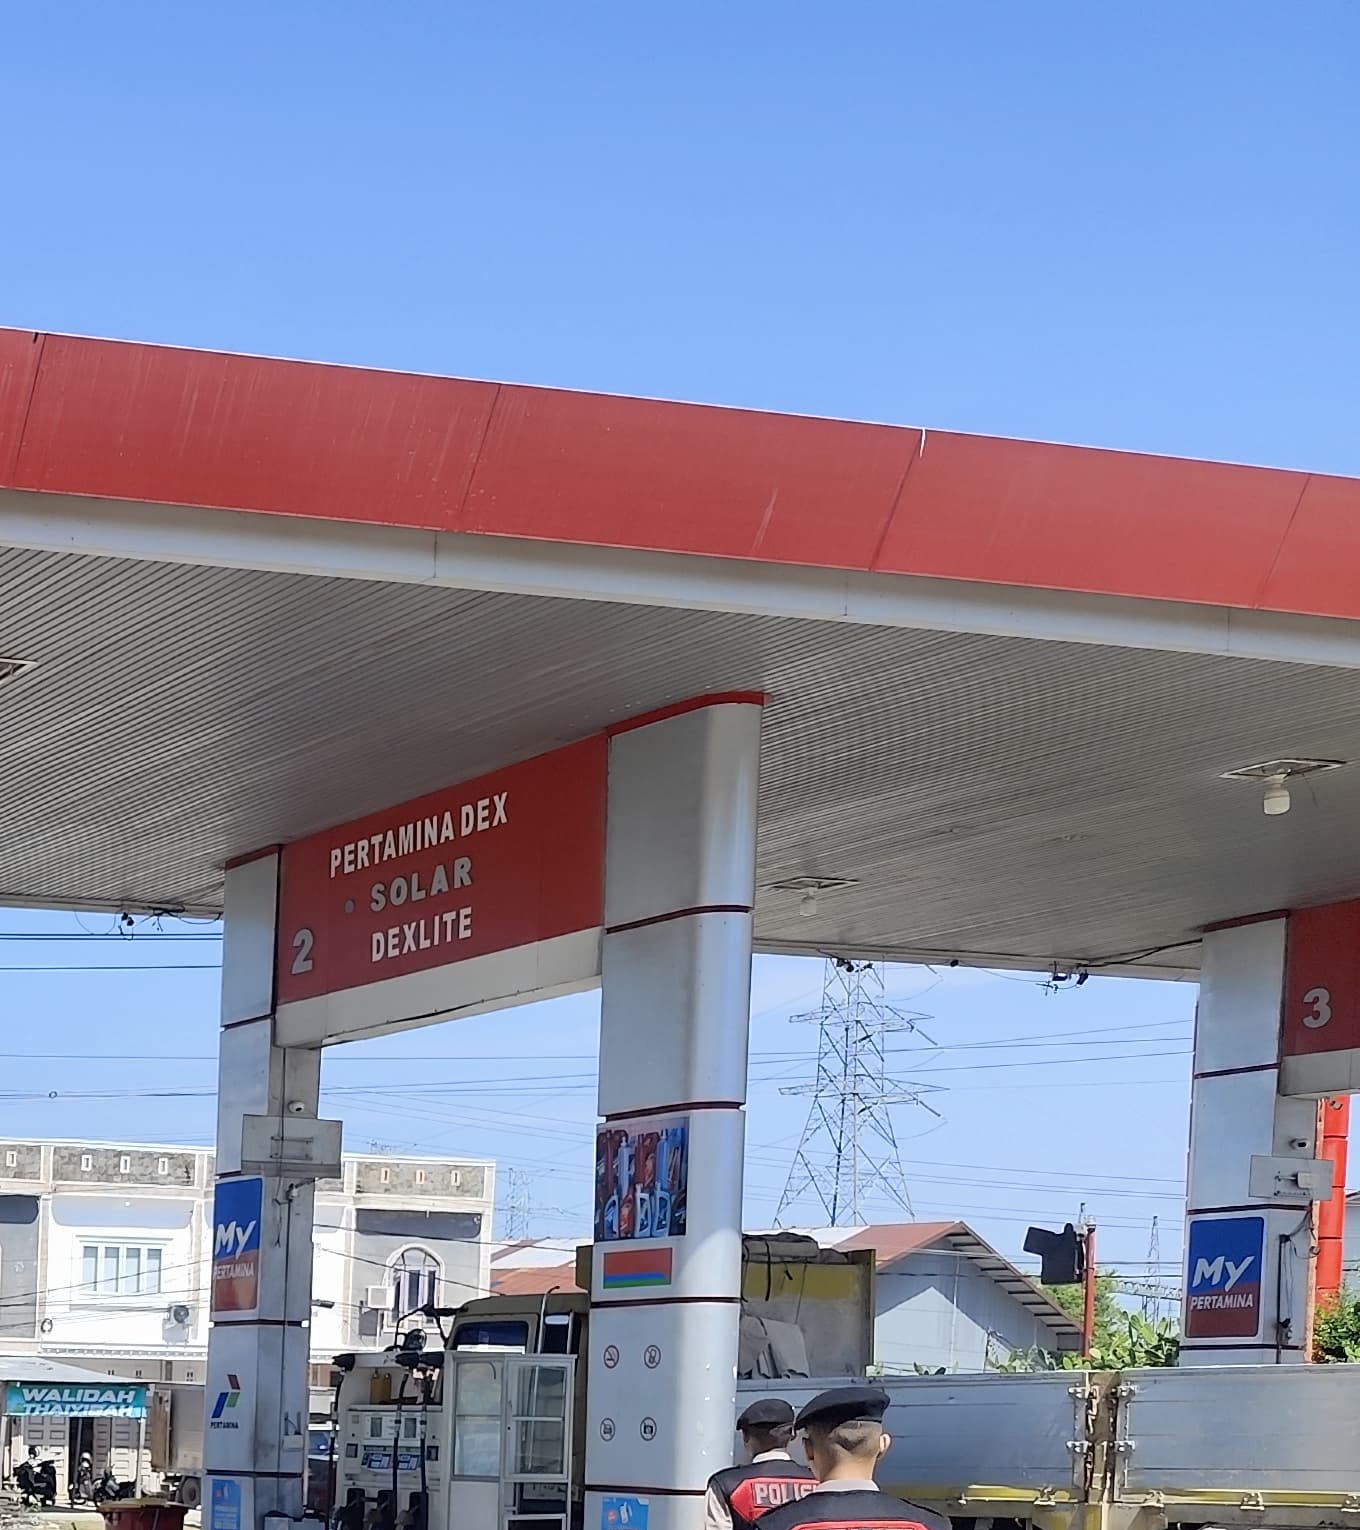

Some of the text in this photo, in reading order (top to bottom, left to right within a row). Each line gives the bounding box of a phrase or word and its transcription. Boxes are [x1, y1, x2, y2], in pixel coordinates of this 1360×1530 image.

[329, 792, 509, 878] PERTAMINA DEX
[370, 856, 473, 912] SOLAR
[290, 928, 315, 975] 2
[371, 906, 473, 962] DEXLITE
[1302, 988, 1332, 1028] 3
[214, 1220, 257, 1261] My
[213, 1262, 255, 1280] PERTAMINA
[1191, 1255, 1256, 1293] My
[1190, 1293, 1254, 1311] PERTAMINA
[22, 1388, 137, 1403] WALIDAH
[210, 1421, 239, 1430] PERTAMINA
